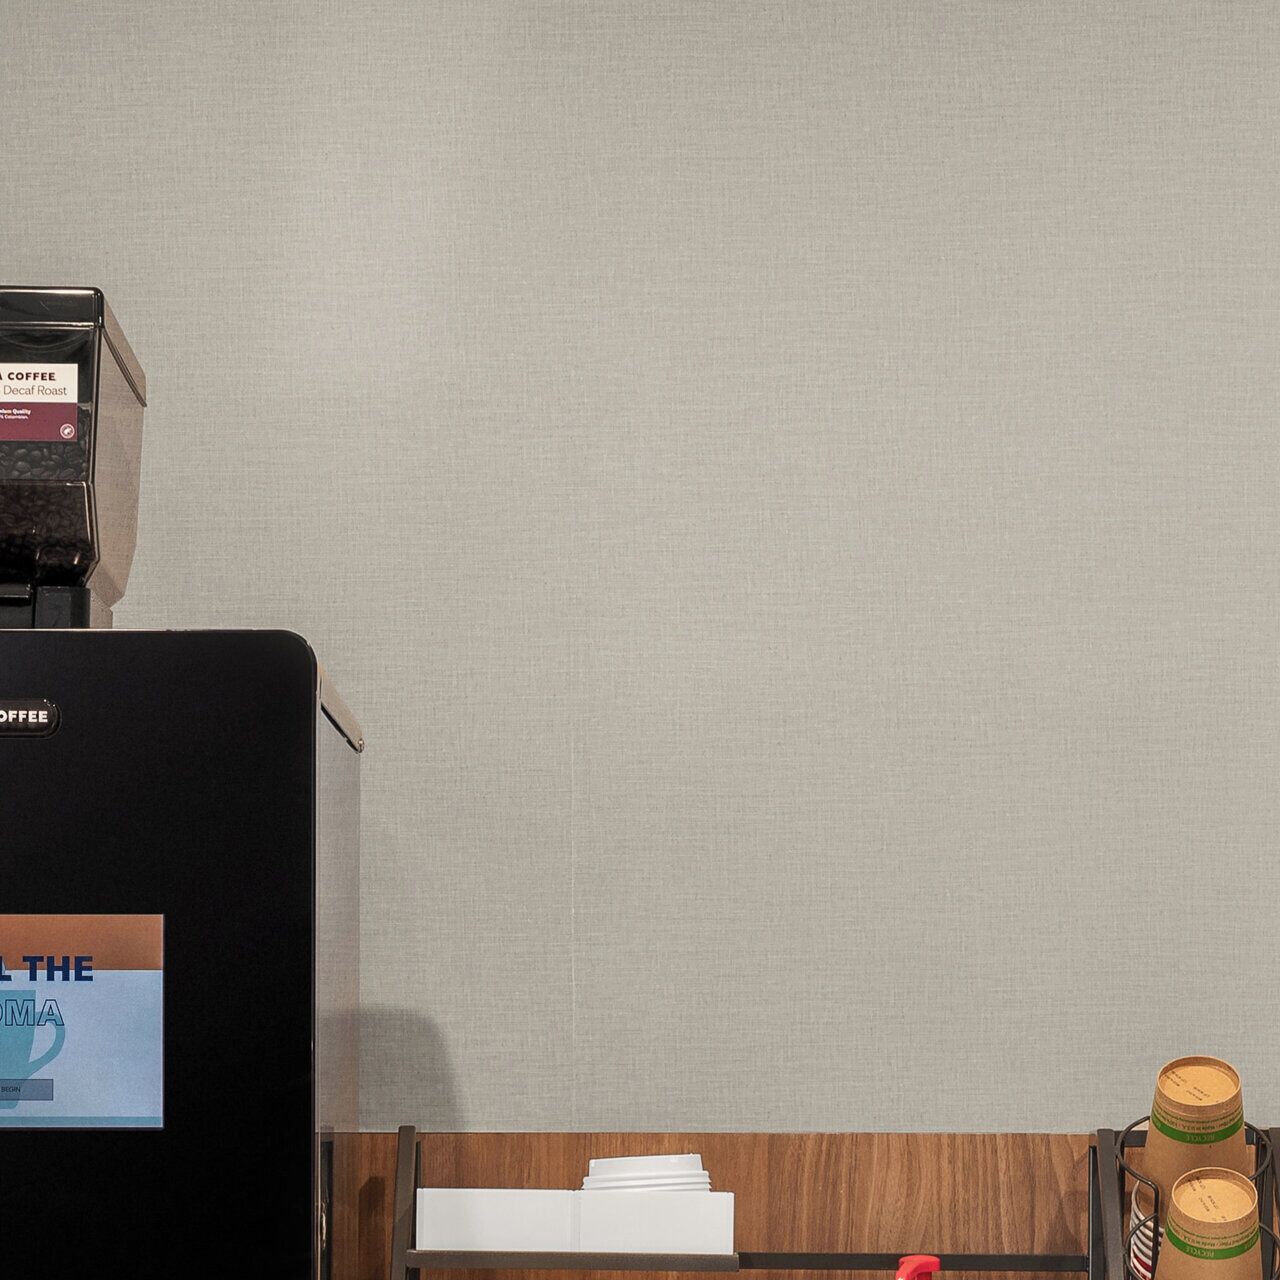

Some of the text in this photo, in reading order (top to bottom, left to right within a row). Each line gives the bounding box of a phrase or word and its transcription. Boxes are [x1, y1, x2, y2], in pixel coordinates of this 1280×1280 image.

[7, 372, 56, 381] COFFEE
[3, 385, 36, 395] Decaf
[37, 385, 67, 395] Roast
[22, 955, 94, 982] THE
[1186, 1246, 1215, 1258] RECYCLE
